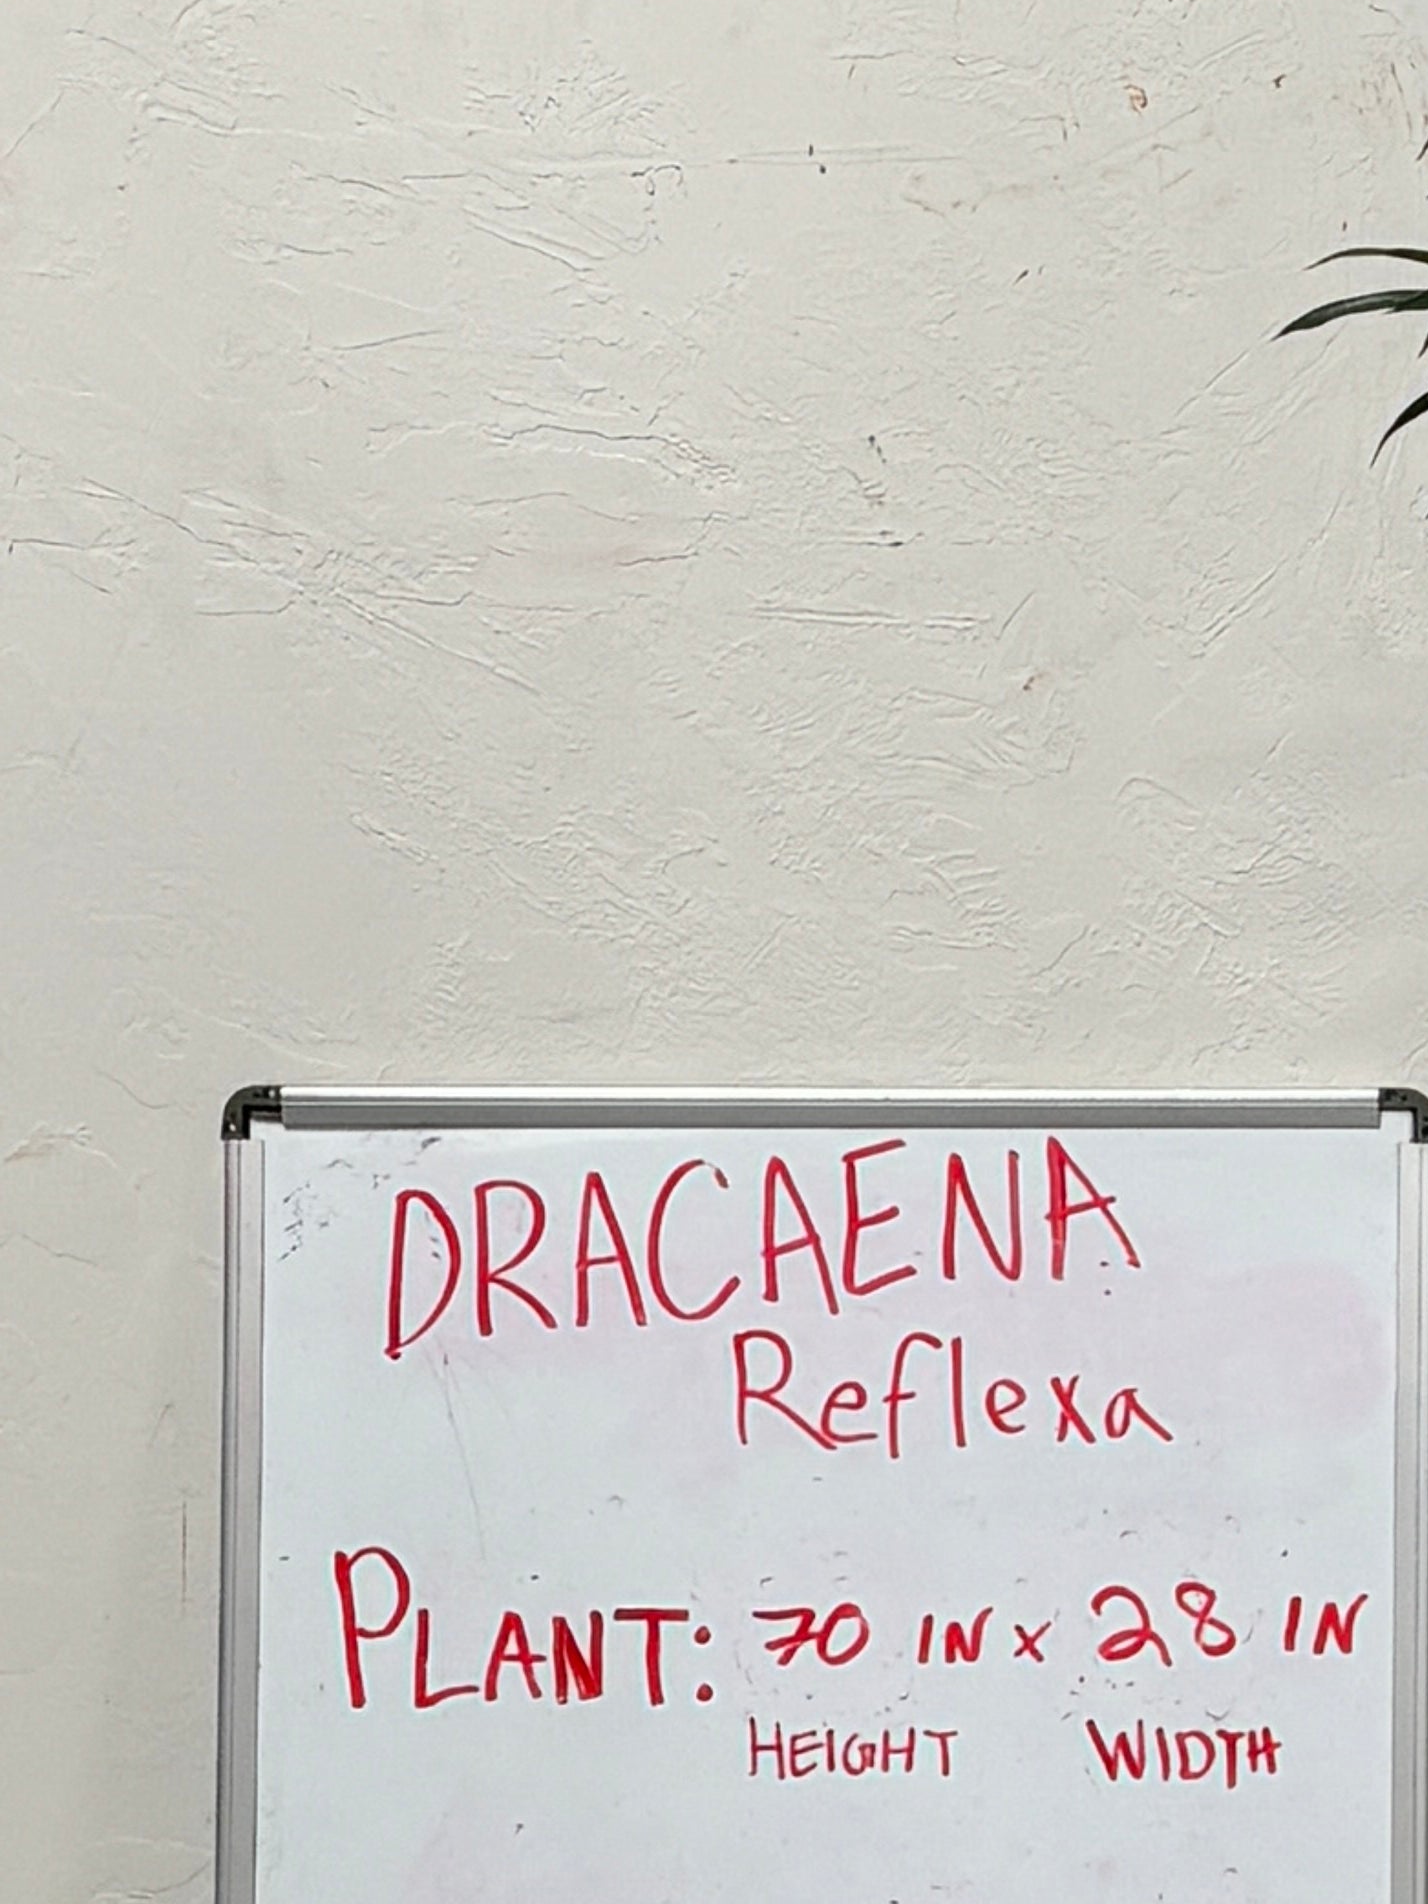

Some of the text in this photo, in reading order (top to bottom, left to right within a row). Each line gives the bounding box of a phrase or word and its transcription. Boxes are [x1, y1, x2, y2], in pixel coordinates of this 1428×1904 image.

[384, 1137, 1141, 1361] DRACAENA
[731, 1328, 1173, 1459] Reflexa
[332, 1546, 715, 1709] PLANT:
[752, 1601, 870, 1667] 70
[917, 1608, 991, 1665] IN
[1089, 1580, 1236, 1665] 28
[1283, 1589, 1368, 1657] IN
[748, 1724, 1281, 1789] HEIGHT WIDTH
